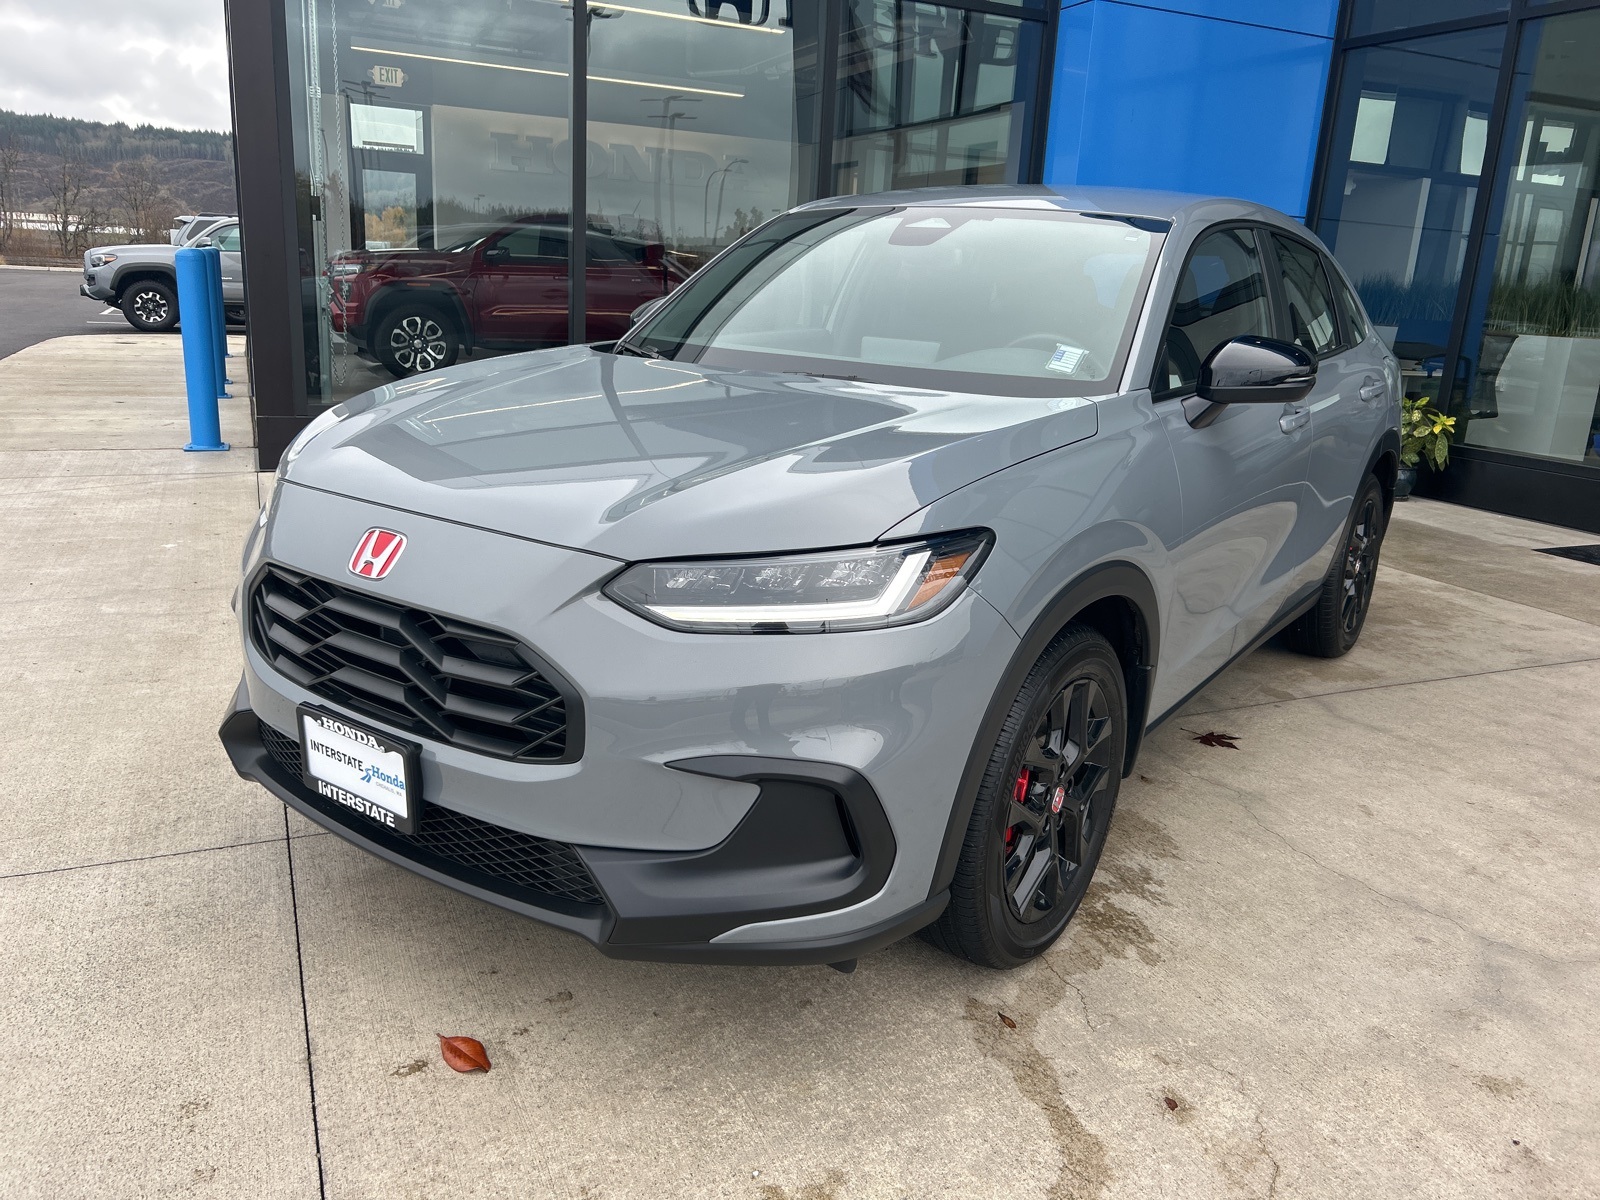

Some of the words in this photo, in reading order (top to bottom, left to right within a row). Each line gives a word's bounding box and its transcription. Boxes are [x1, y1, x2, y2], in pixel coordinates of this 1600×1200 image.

[379, 67, 398, 84] EXIT
[321, 716, 380, 750] HONDA
[310, 739, 365, 772] INTERSTATE
[371, 765, 406, 791] Honda
[318, 780, 396, 828] INTERSTATE
